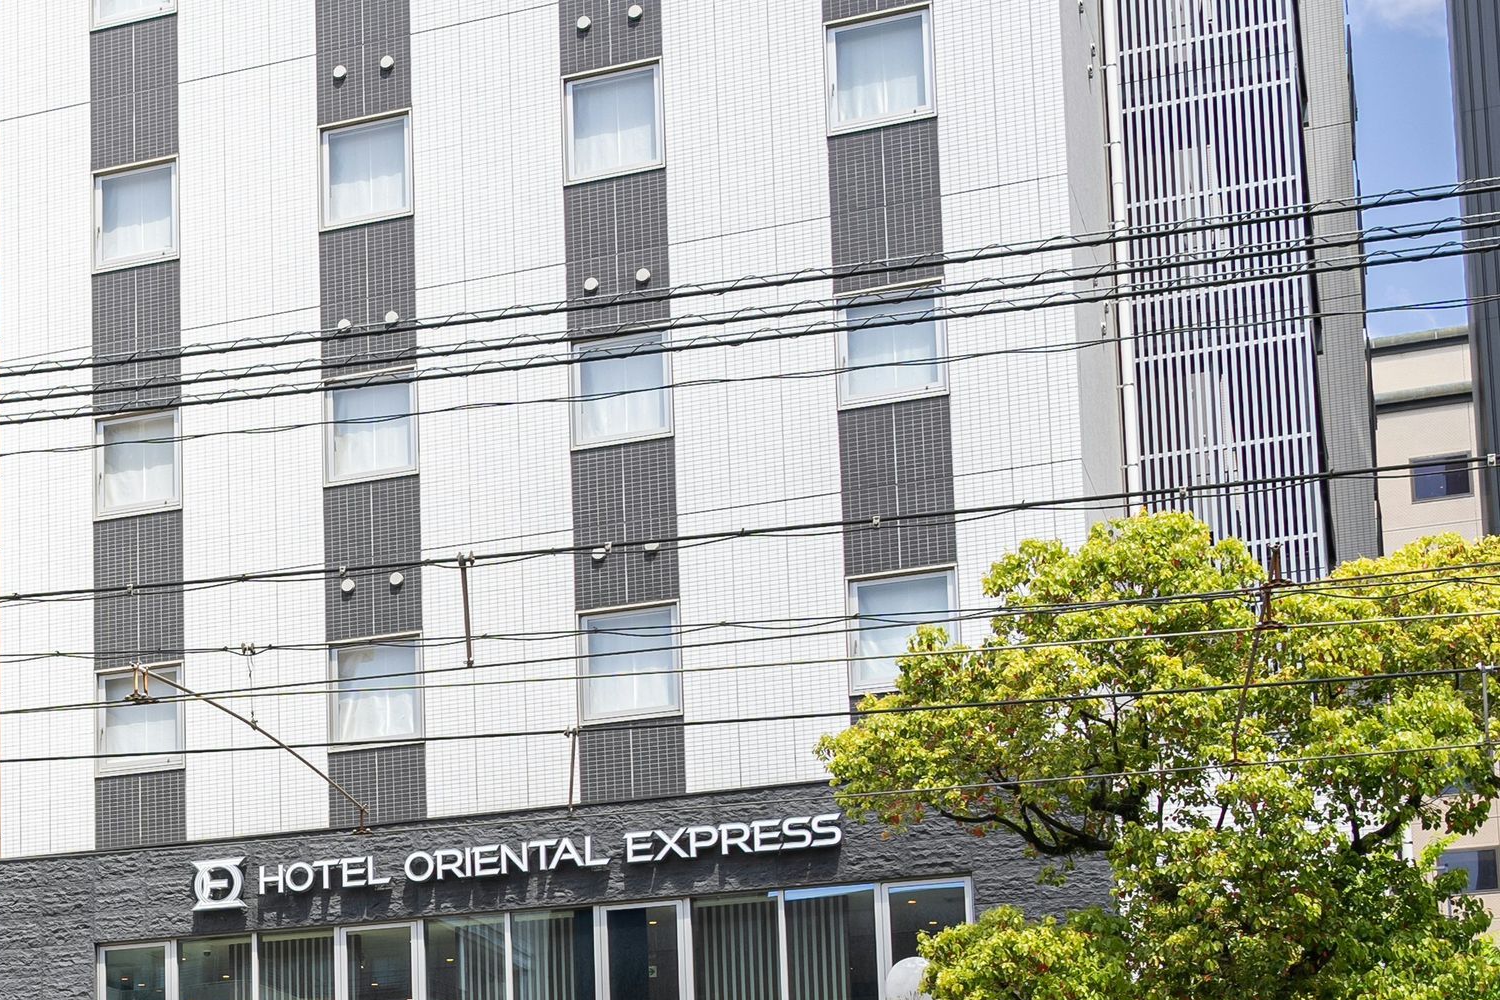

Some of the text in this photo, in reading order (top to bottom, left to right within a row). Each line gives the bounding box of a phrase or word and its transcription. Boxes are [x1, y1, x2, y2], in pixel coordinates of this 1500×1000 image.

[257, 812, 843, 896] HOTEL ORIENTAL EXPRESS
